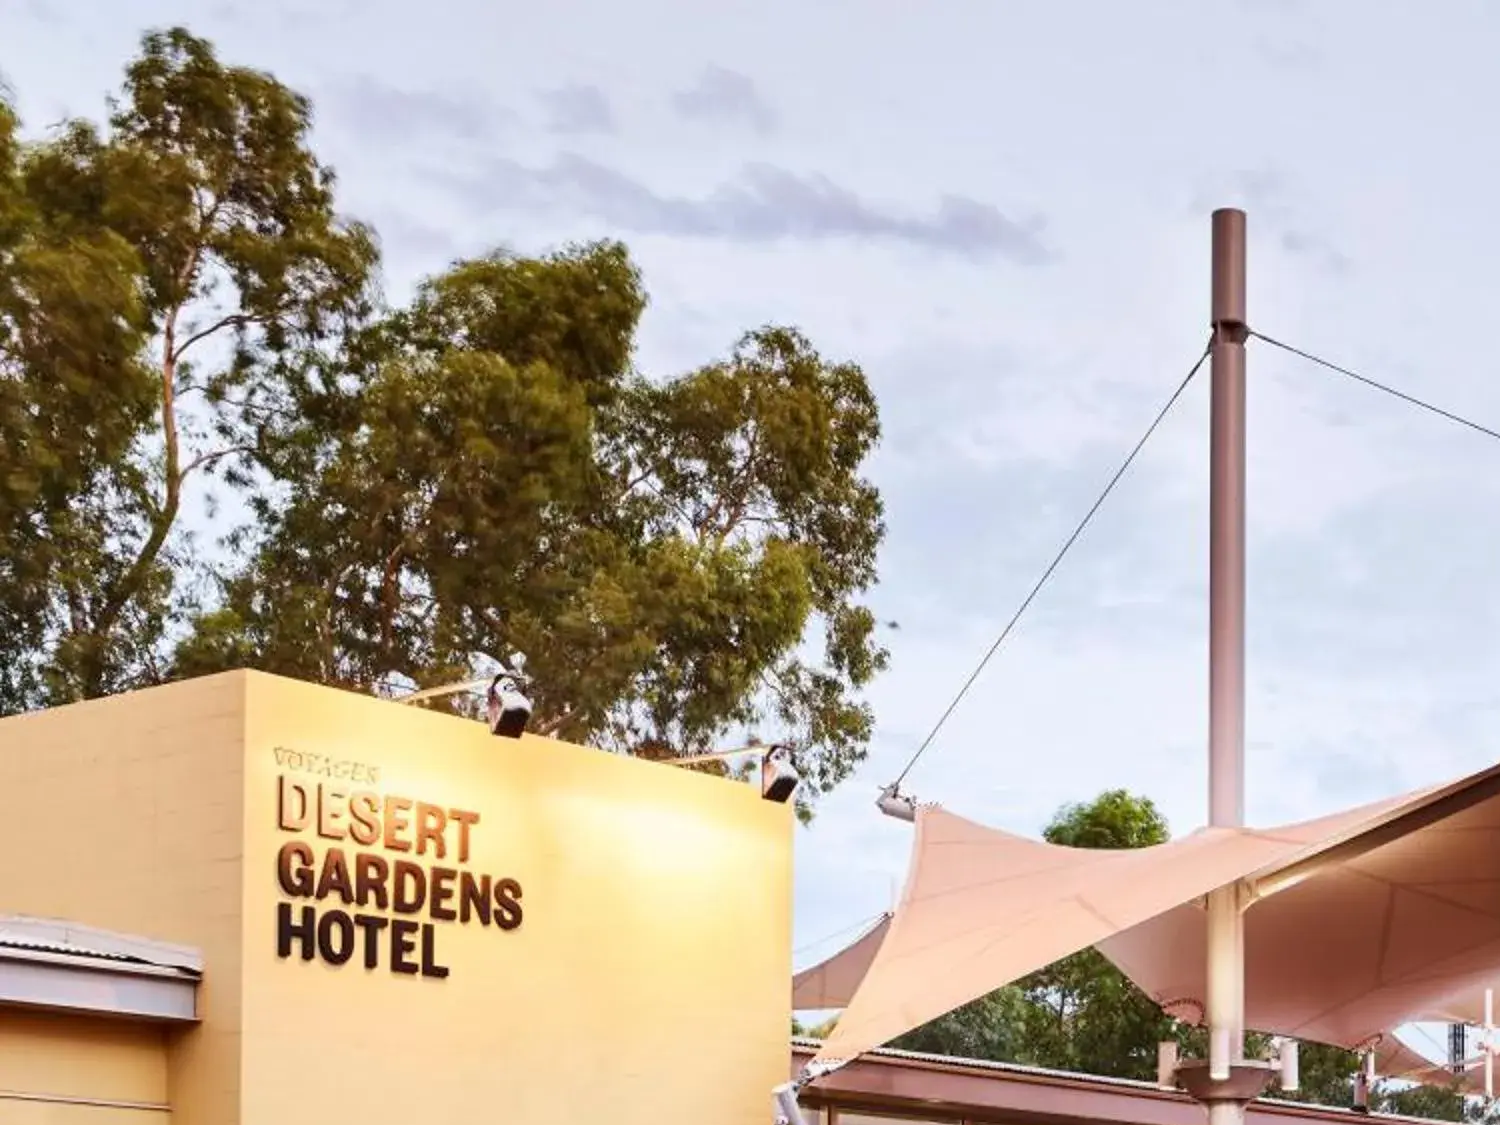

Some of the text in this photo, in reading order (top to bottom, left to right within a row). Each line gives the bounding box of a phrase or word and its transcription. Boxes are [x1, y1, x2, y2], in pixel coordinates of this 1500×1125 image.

[273, 746, 381, 785] VOYAGES
[276, 774, 481, 864] DESERT
[277, 840, 524, 931] GARDENS
[276, 901, 450, 979] HOTEL
